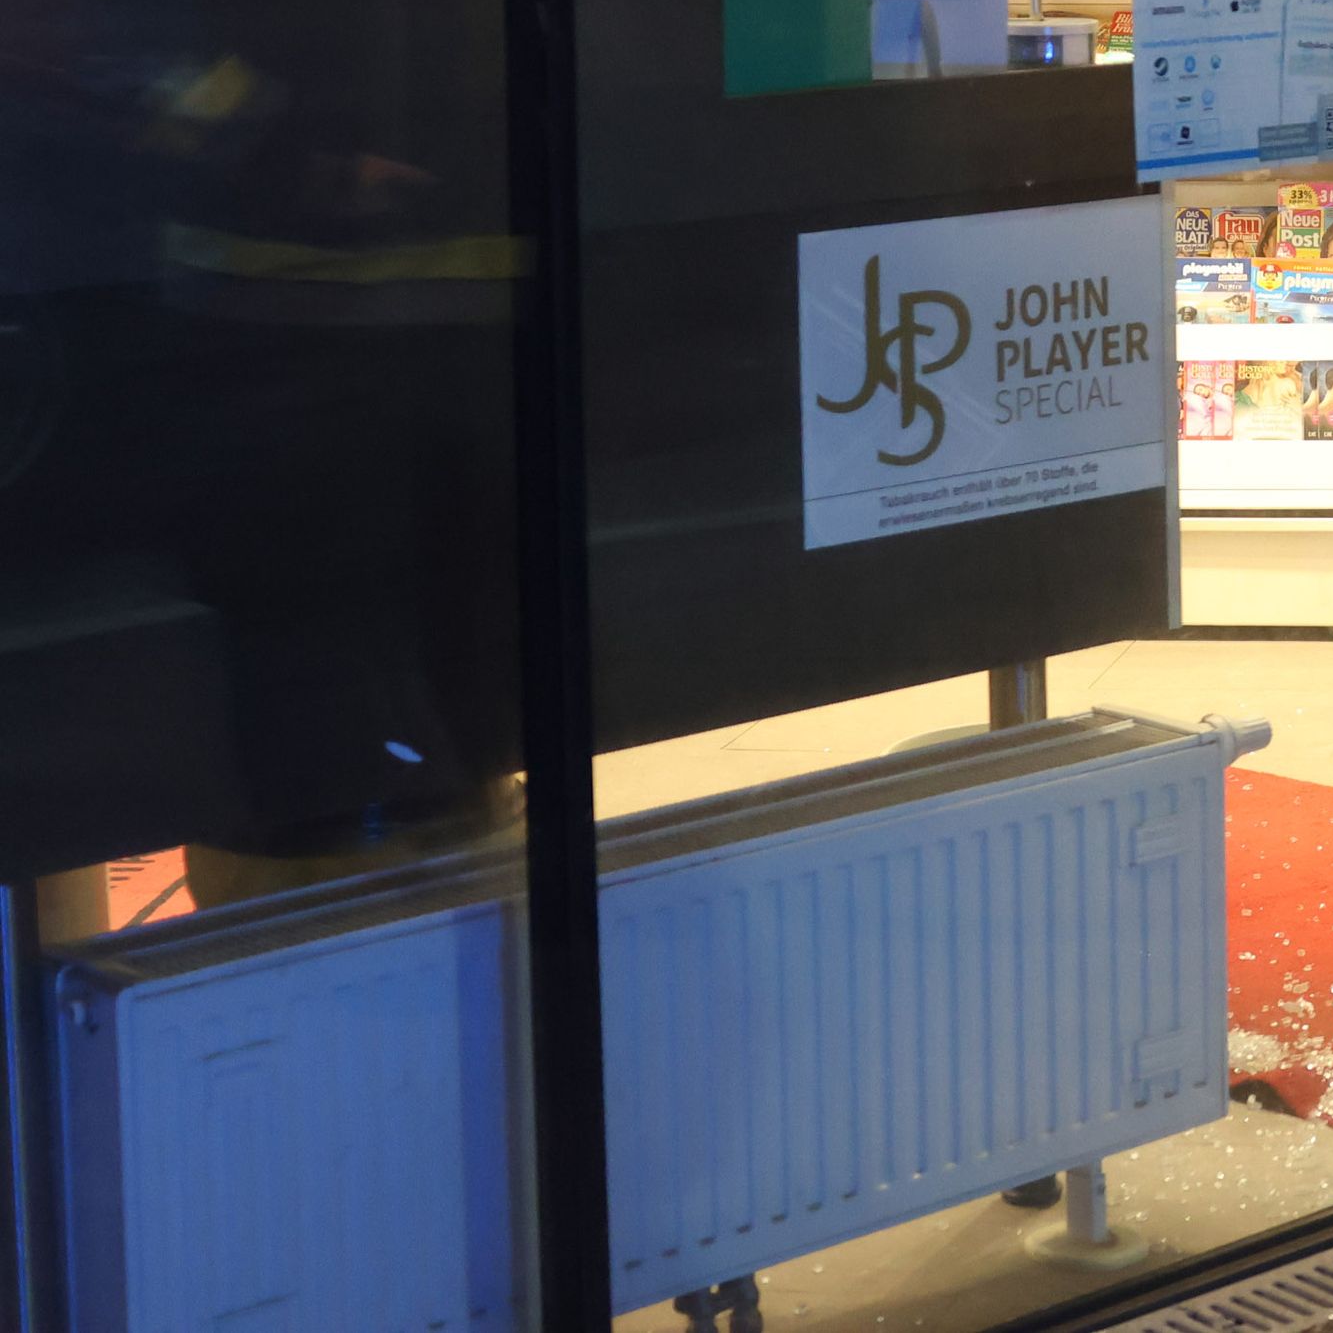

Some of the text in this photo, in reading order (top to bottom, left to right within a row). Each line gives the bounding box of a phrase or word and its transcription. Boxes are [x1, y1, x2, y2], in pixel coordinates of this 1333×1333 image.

[1290, 189, 1313, 200] 33%
[1176, 218, 1209, 232] NEUE
[1281, 211, 1320, 227] Neue
[1175, 230, 1210, 245] BLATT
[1281, 229, 1321, 248] Post
[1182, 262, 1245, 275] playmobil
[994, 276, 1110, 331] JOHN
[996, 321, 1150, 383] PLAYER
[994, 375, 1123, 425] SPECIAL
